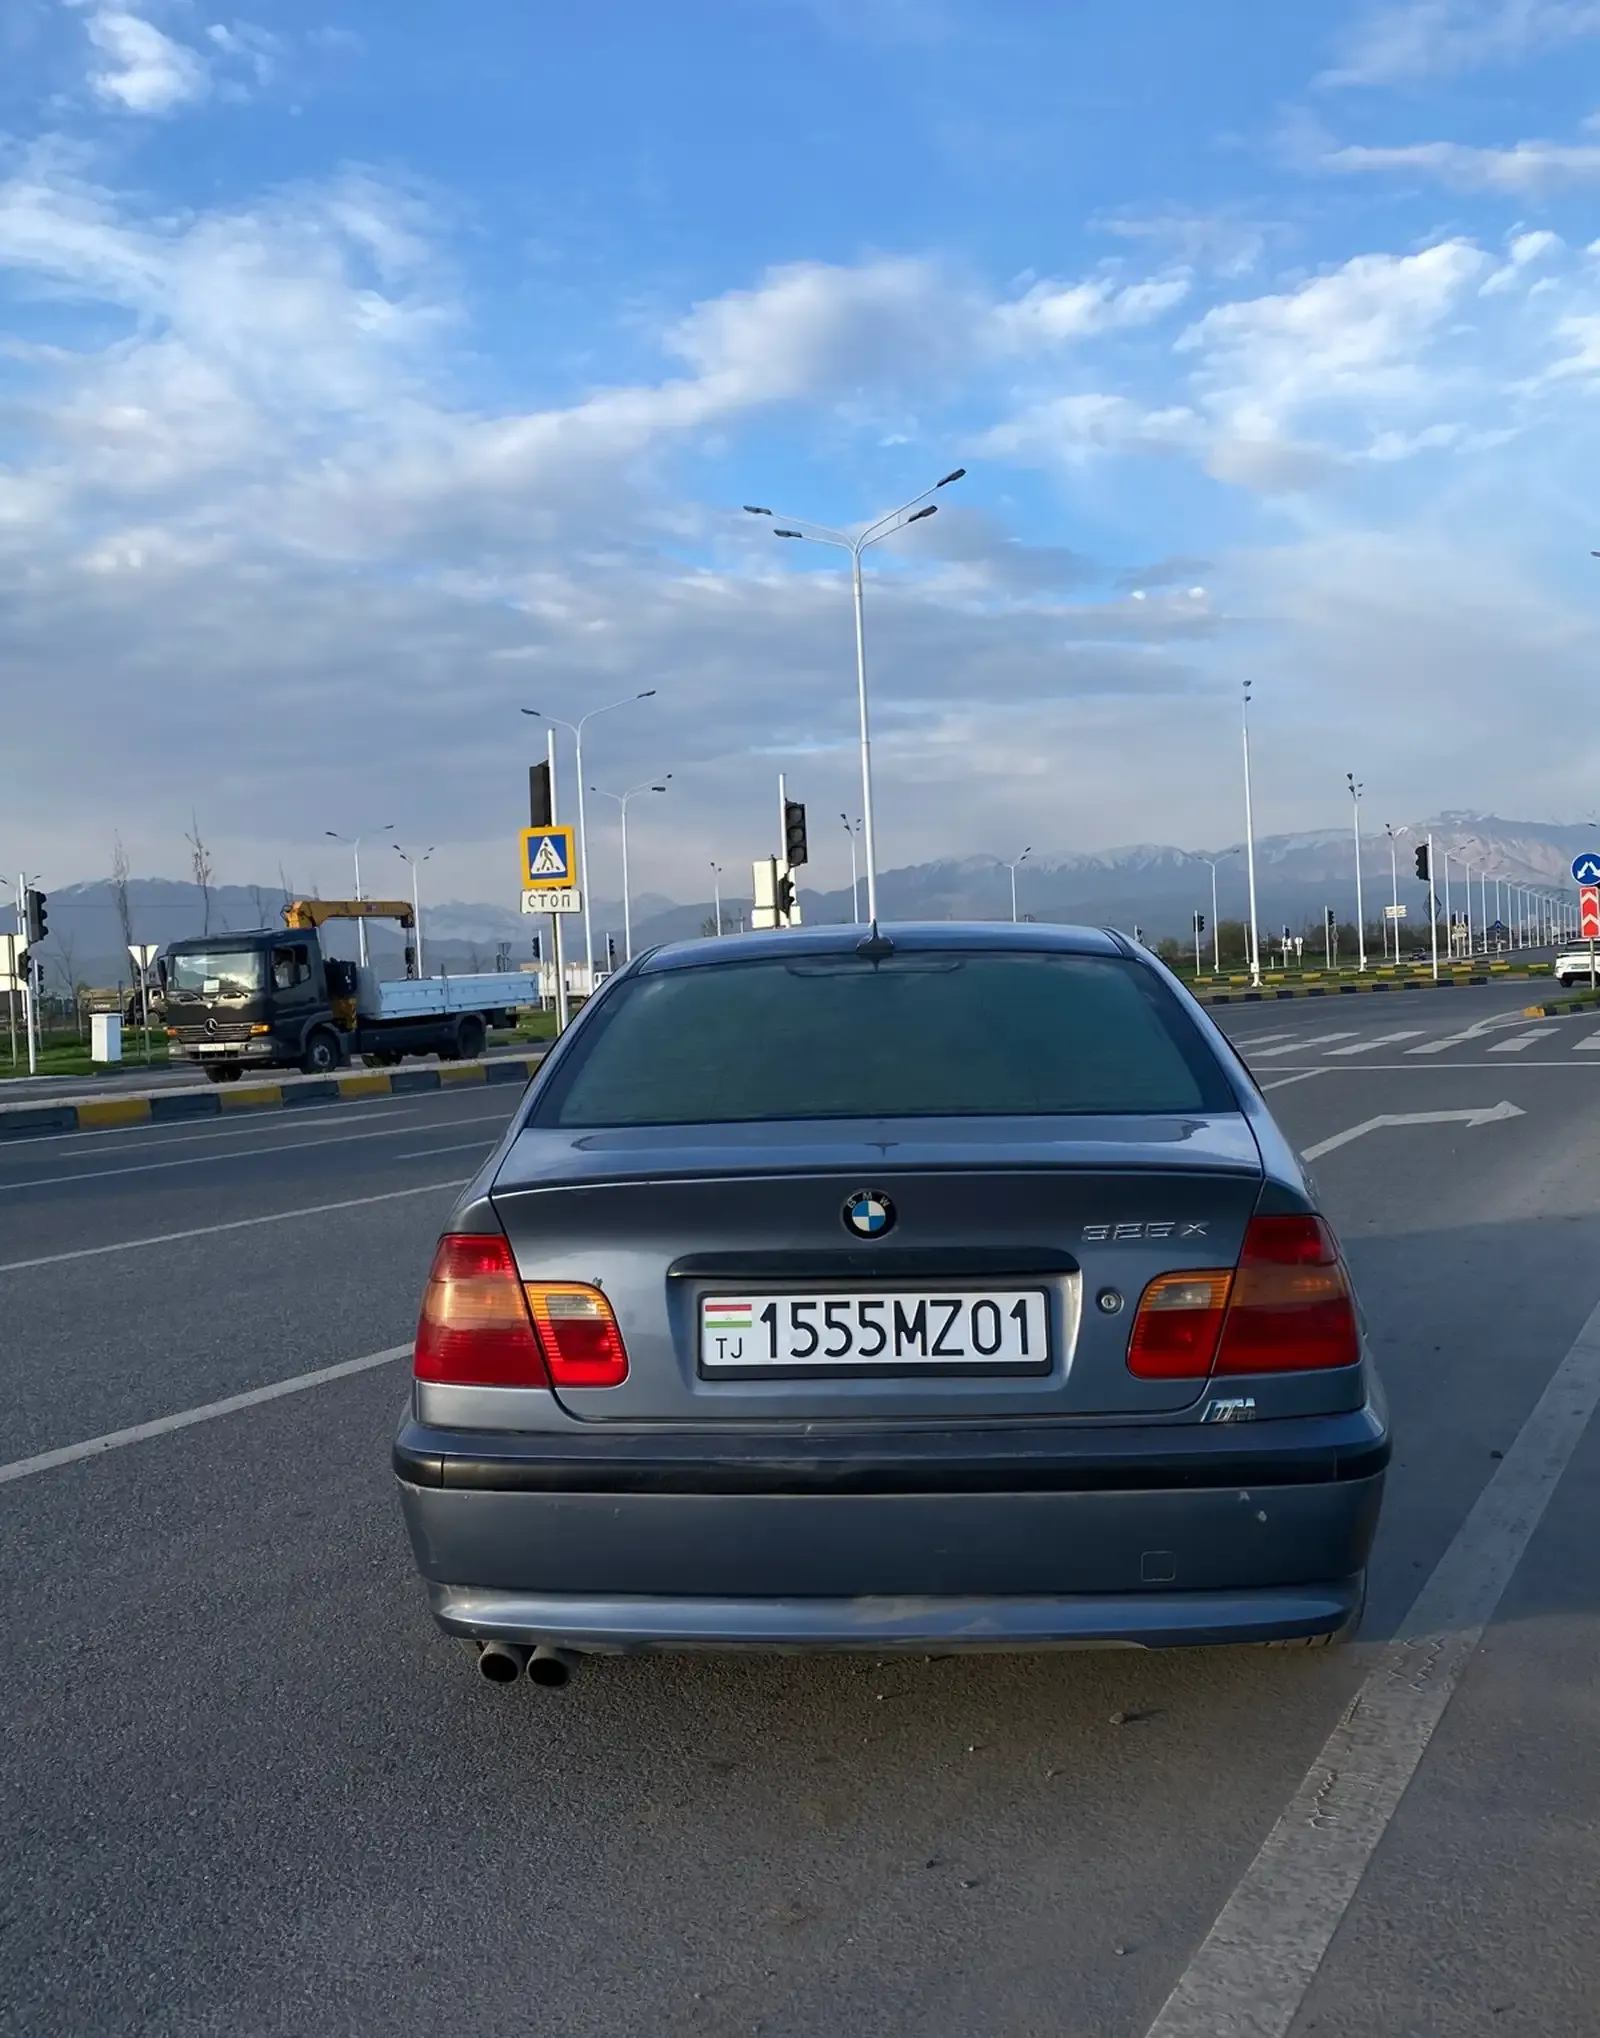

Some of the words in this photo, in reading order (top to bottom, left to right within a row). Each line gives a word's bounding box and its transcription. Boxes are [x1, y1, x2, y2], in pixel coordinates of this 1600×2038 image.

[527, 894, 571, 908] СТОП
[847, 1191, 890, 1209] BMW
[759, 1299, 1029, 1358] 1555MZ01
[715, 1337, 743, 1359] TJ
